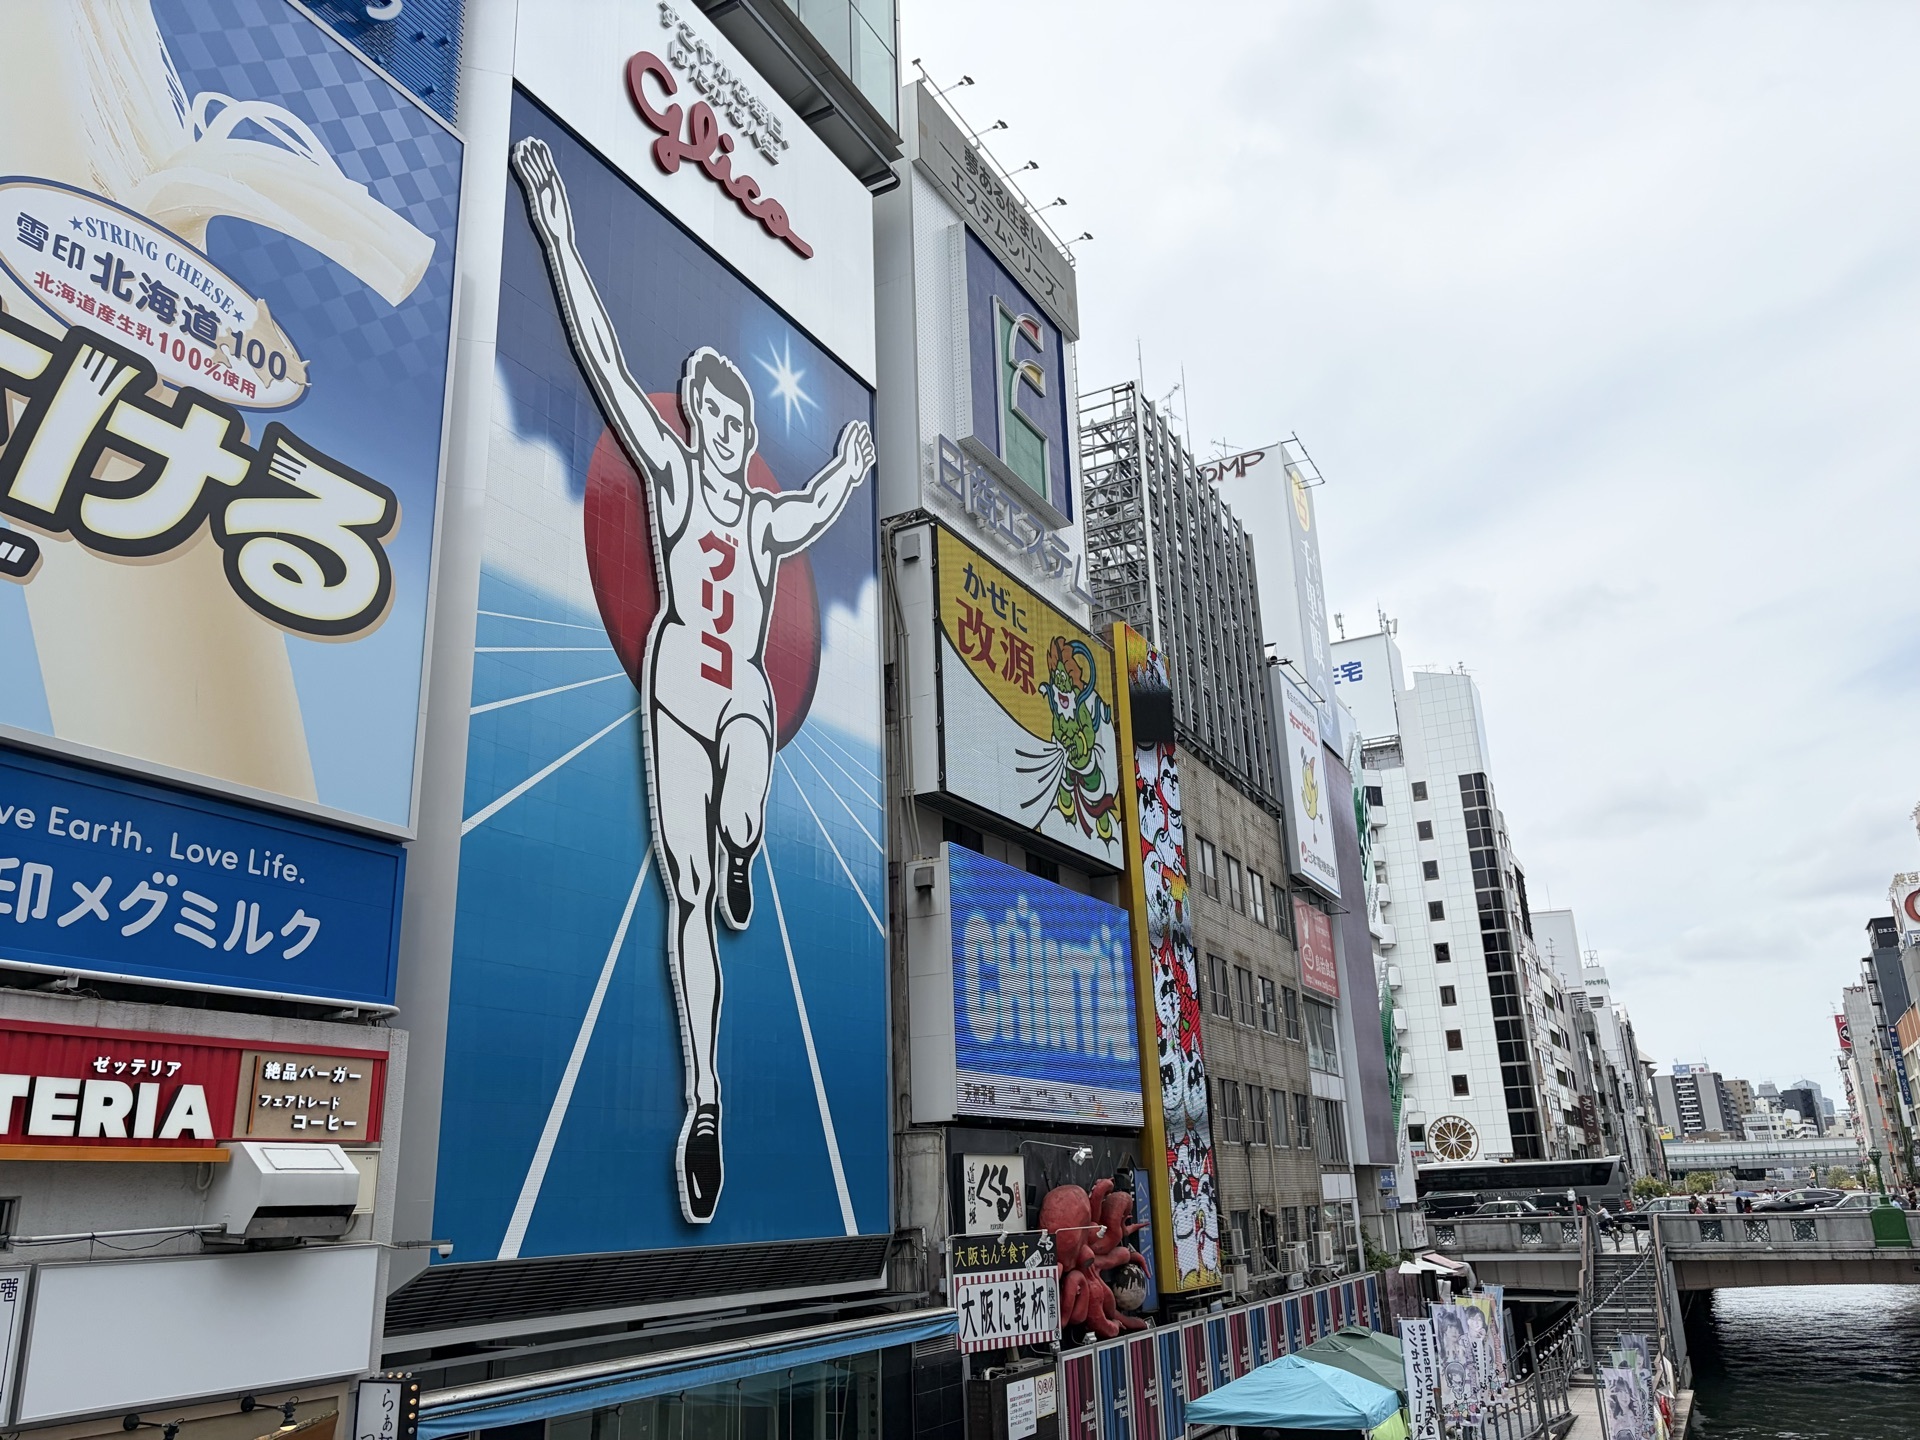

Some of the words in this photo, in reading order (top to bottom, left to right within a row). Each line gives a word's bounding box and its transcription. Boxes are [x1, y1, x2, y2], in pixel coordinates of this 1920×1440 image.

[627, 51, 814, 260] Glico
[951, 166, 1057, 306] エステムシリーズ
[964, 145, 1042, 253] 夢ある住まい
[84, 215, 160, 262] STRING
[165, 252, 235, 317] CHEESE
[34, 270, 257, 400] 北海道産生乳100%使用
[934, 433, 1098, 606] 日商エステム
[698, 530, 739, 691] グリコ
[963, 561, 1028, 634] かぜに
[956, 596, 1038, 696] 改源
[48, 806, 153, 854] Earth.
[169, 832, 239, 870] Love
[248, 848, 306, 884] Life.
[92, 1056, 182, 1078] ゼッテリア
[260, 1094, 341, 1110] フェアトレード
[264, 1061, 362, 1084] 絶品バーガー
[292, 1114, 357, 1131] コーヒー
[955, 1242, 1029, 1267] 大阪もんを食す
[1043, 1253, 1056, 1266] 2F
[961, 1281, 1046, 1339] 大阪に乾杯
